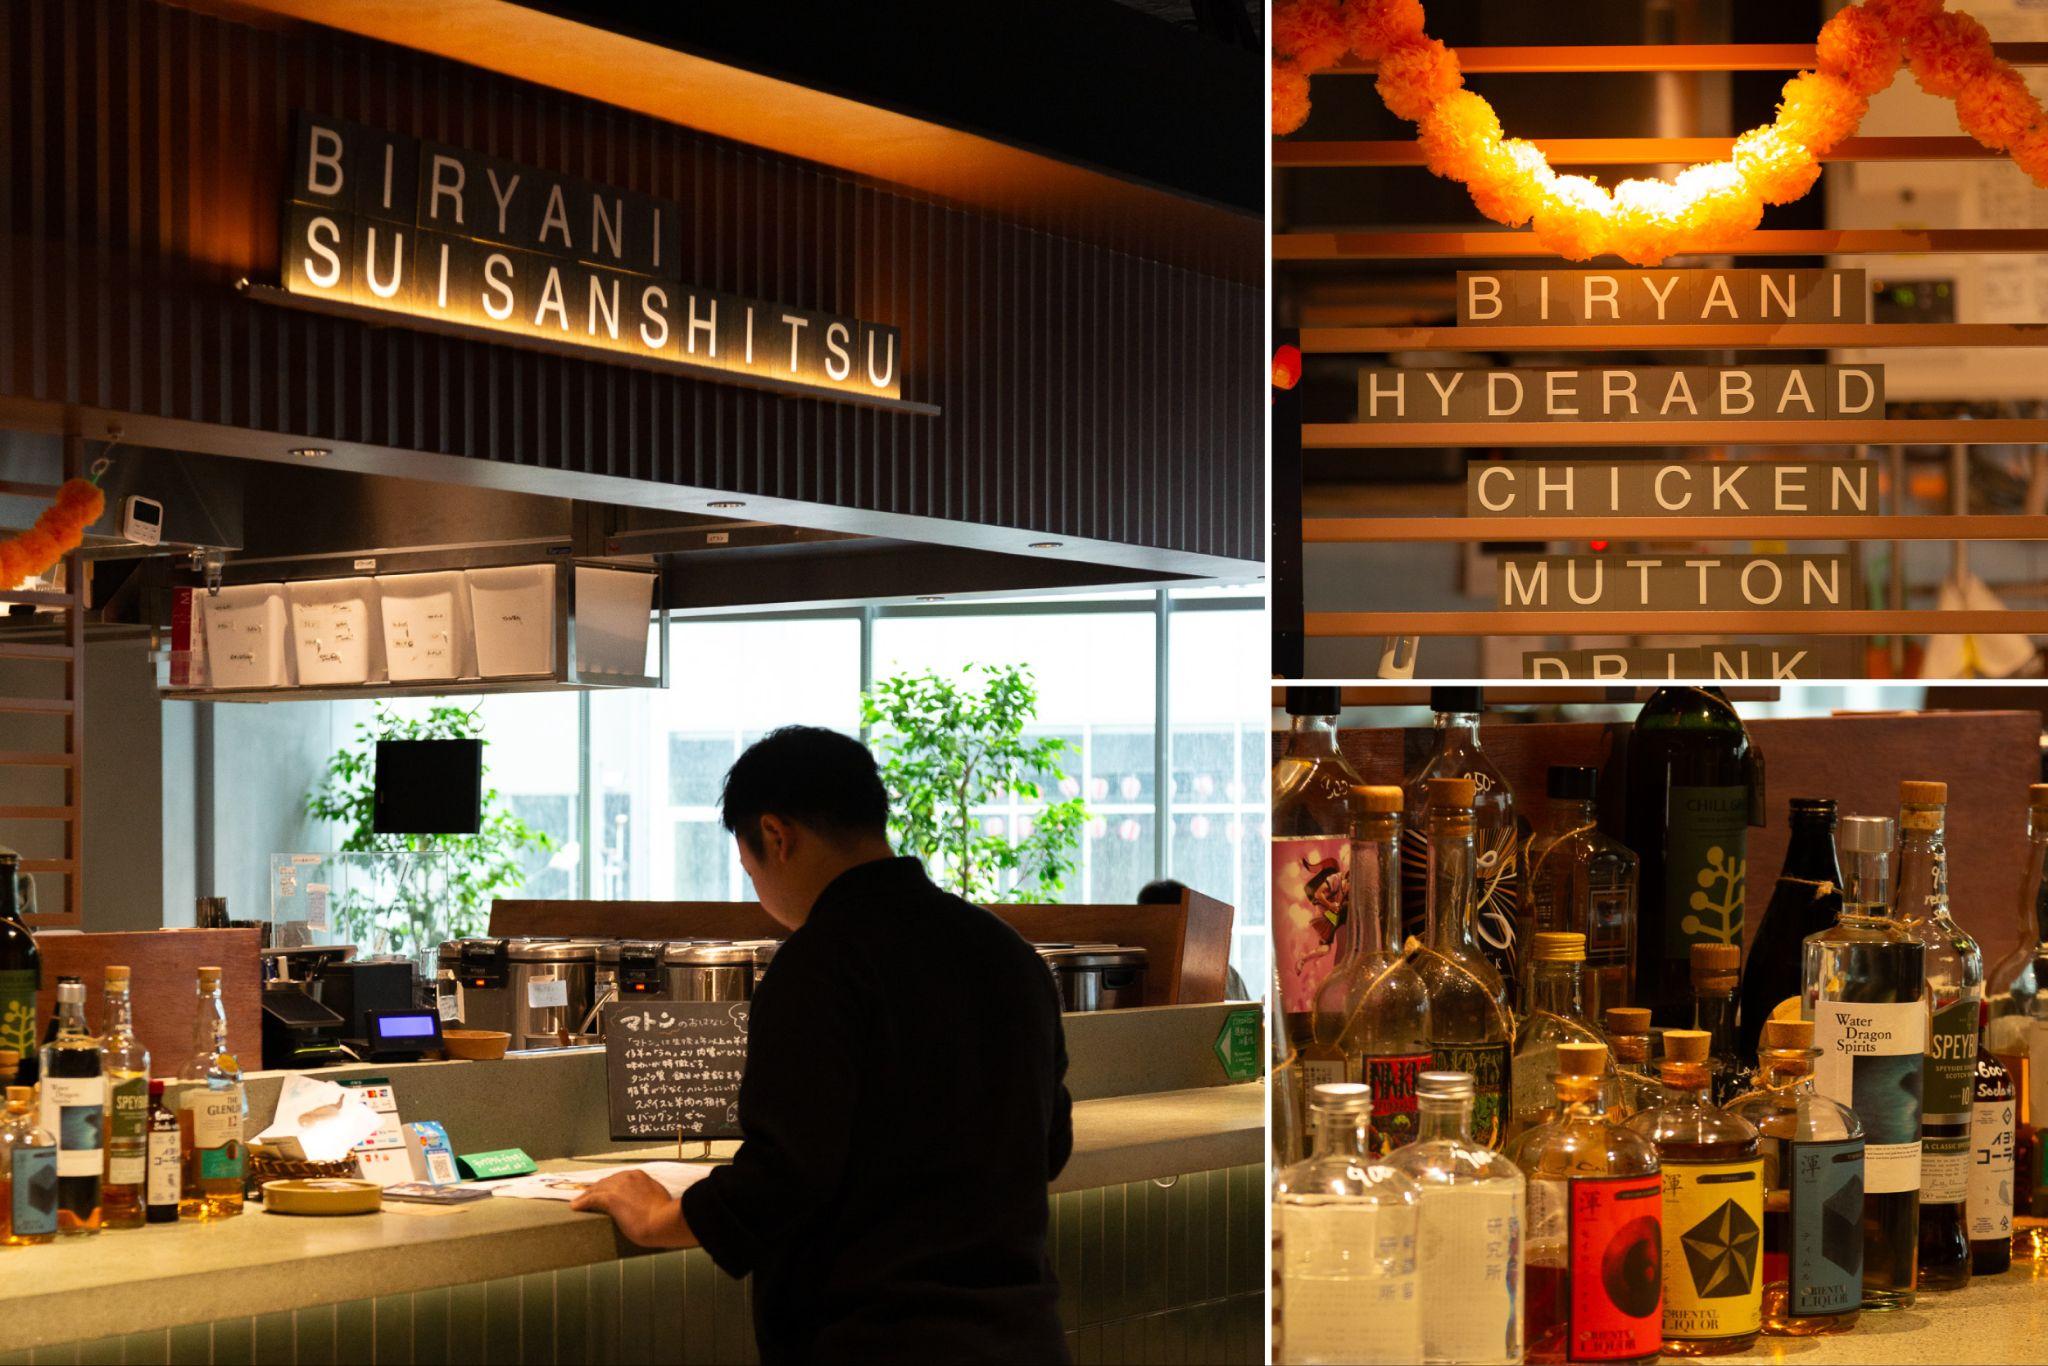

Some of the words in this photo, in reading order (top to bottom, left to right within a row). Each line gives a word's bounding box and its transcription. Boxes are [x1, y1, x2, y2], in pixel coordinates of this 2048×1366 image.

[308, 125, 662, 267] BIRYANI
[304, 216, 895, 389] SUISANSHITSU
[1467, 273, 1843, 320] BIRYANI
[1369, 368, 1876, 417] HYDERABAD
[1477, 465, 1869, 511] CHICKEN
[1505, 559, 1841, 605] MUTTON
[1835, 1013, 1873, 1027] Water
[1846, 1027, 1892, 1042] Dragon
[1836, 1040, 1876, 1054] Spirits
[1932, 1033, 1976, 1060] SPEYB
